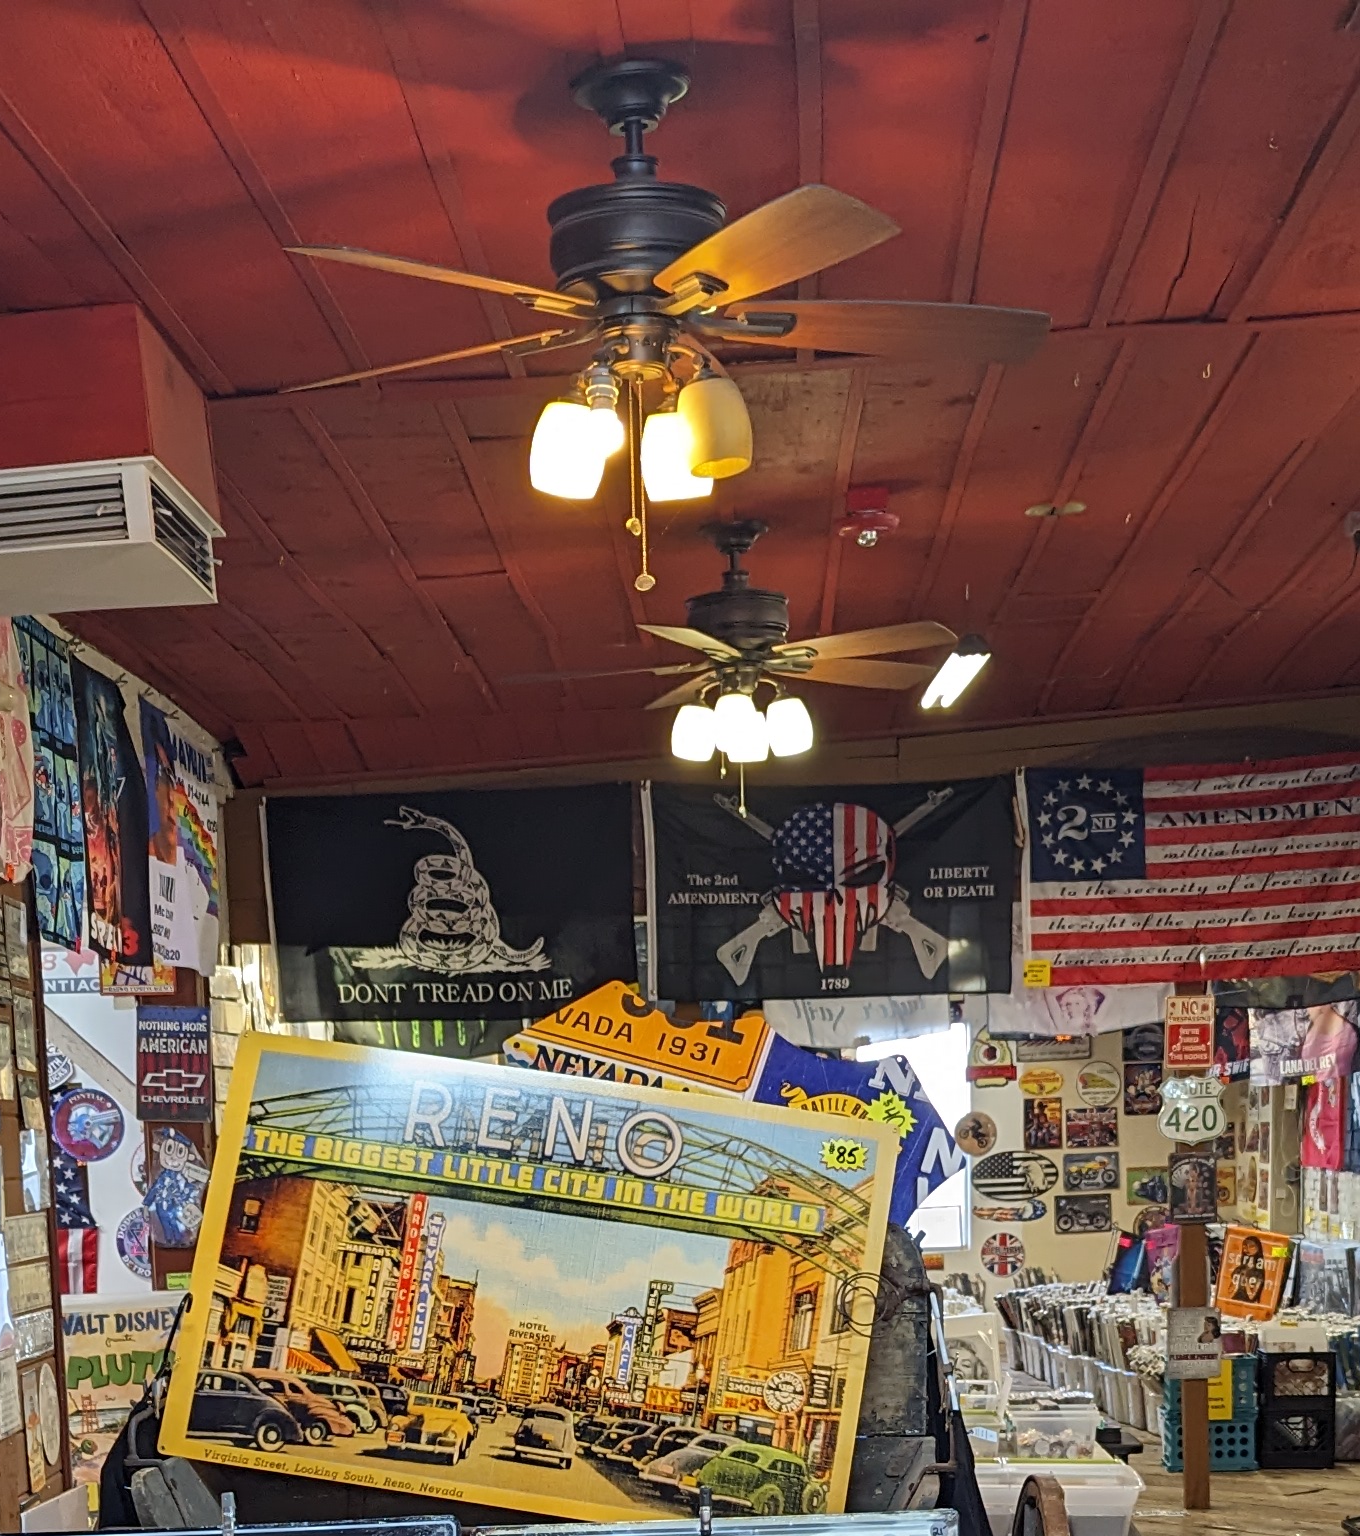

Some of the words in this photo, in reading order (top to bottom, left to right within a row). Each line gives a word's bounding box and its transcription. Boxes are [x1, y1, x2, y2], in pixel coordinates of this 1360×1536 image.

[687, 873, 712, 886] The
[716, 873, 738, 886] 2nd
[929, 866, 989, 881] LIBERTY
[923, 885, 942, 899] OR
[946, 883, 995, 898] DEATH
[1124, 877, 1209, 896] security
[668, 892, 760, 906] AMENDMENT
[1079, 916, 1127, 934] right
[1192, 911, 1258, 930] people
[338, 979, 405, 1004] DONT
[412, 980, 493, 1004] TREAD
[499, 980, 533, 1001] ON
[539, 977, 573, 999] ME
[820, 976, 851, 991] 1789
[1181, 1001, 1198, 1015] NO
[138, 1021, 180, 1032] NOTHING
[182, 1022, 208, 1032] MORE
[140, 1038, 208, 1055] AMERICAN
[658, 1032, 721, 1066] 1931
[533, 1046, 666, 1088] NEVADA
[1280, 1059, 1303, 1074] LANA
[1319, 1053, 1337, 1069] REY
[141, 1095, 206, 1105] CHEVROLET
[404, 1080, 684, 1178] RENO
[1165, 1105, 1218, 1133] 420
[829, 1142, 858, 1165] $85
[253, 1128, 305, 1156] THE
[313, 1138, 434, 1175] BIGGEST
[443, 1153, 533, 1190] LITTLE
[543, 1166, 606, 1200] CITY
[614, 1177, 643, 1203] IN
[654, 1184, 707, 1214] THE
[715, 1193, 821, 1231] WORLD
[421, 1220, 442, 1296] NEVADA
[361, 1258, 381, 1329] BINGO
[62, 1312, 110, 1336] WALT
[114, 1308, 180, 1334] DISNEY
[391, 1288, 408, 1347] CLUB
[411, 1302, 428, 1351] CLUB
[519, 1321, 549, 1332] HOTEL
[509, 1329, 557, 1344] RIVERSIDE
[616, 1324, 637, 1387] CAFE
[728, 1380, 763, 1395] SMOKE
[204, 1448, 249, 1466] Virginia
[254, 1456, 290, 1472] Street,
[294, 1462, 339, 1480] Looking
[343, 1470, 378, 1485] South,
[383, 1477, 415, 1491] Reno,
[419, 1482, 465, 1498] Nevada
